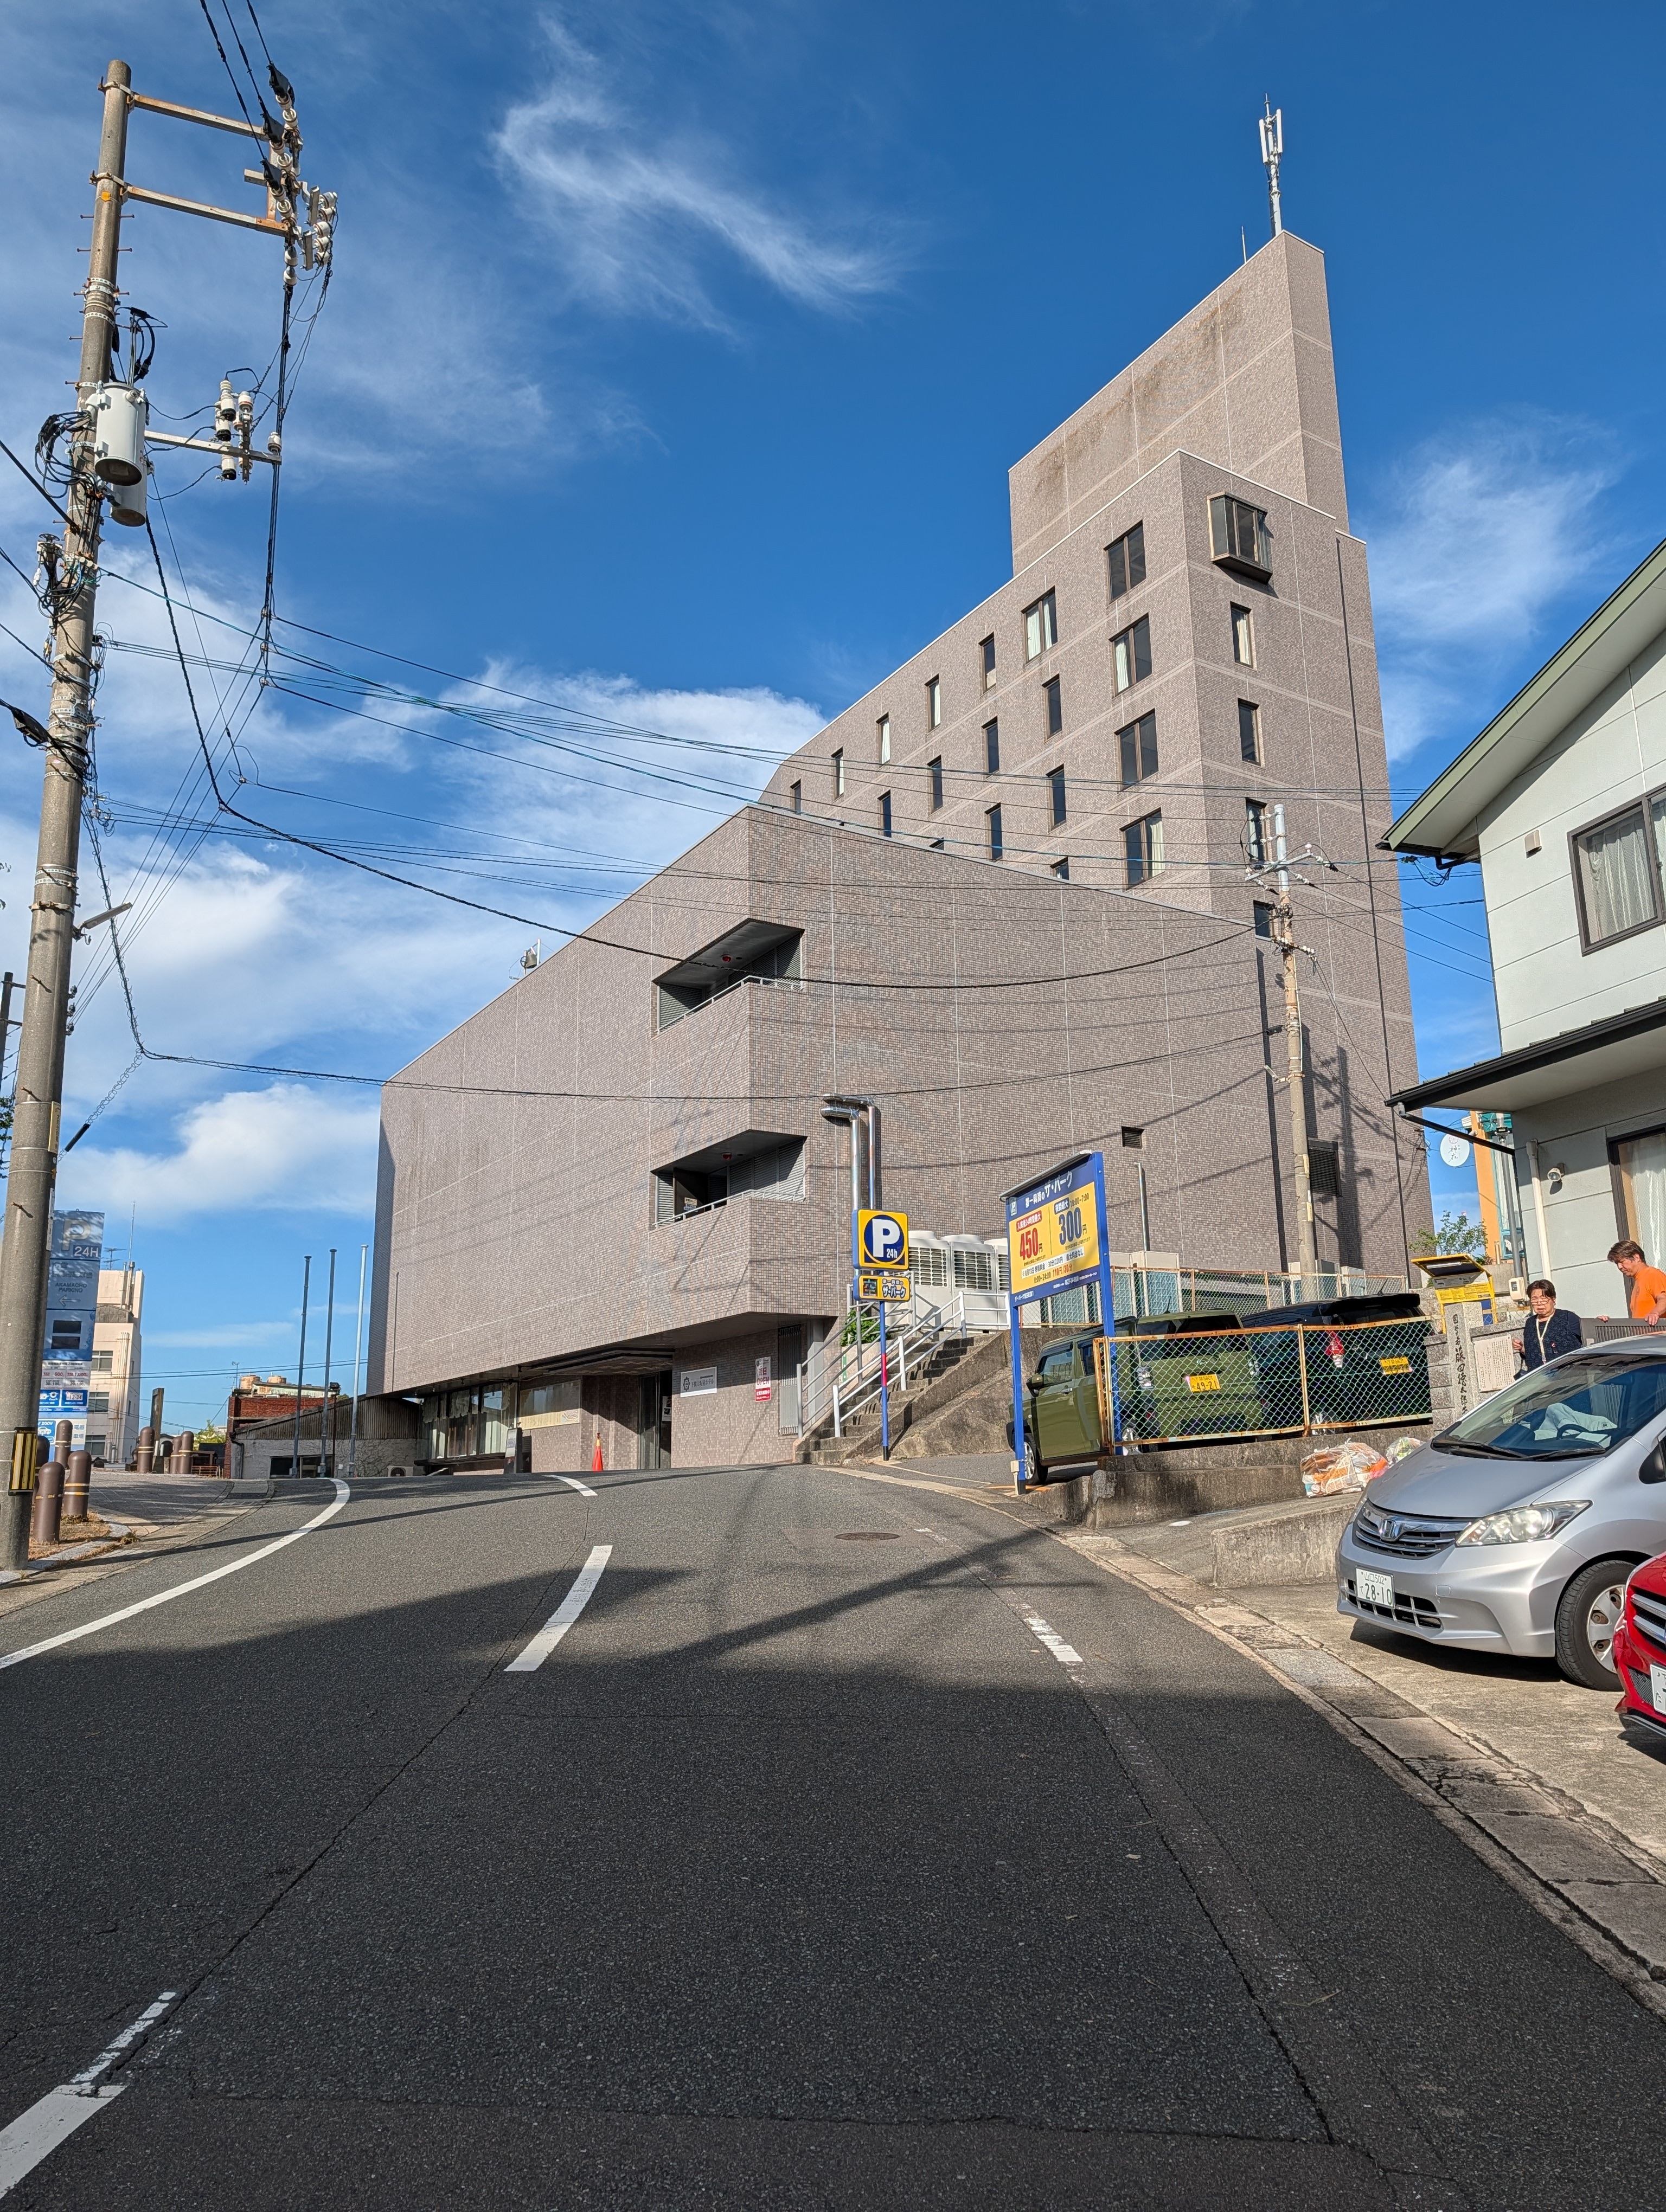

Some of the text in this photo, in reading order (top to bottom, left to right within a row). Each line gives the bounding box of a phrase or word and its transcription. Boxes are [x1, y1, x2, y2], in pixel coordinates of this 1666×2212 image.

[1059, 1207, 1087, 1245] 300円
[62, 1218, 91, 1251] P
[872, 1218, 900, 1257] P
[1020, 1227, 1043, 1261] 450円
[74, 1246, 99, 1258] 24H
[886, 1248, 898, 1258] 24h
[863, 1279, 877, 1296] 空
[882, 1284, 906, 1298] ザ・パーク
[757, 1377, 770, 1386] OPEN
[1196, 1380, 1218, 1391] 49-21
[1364, 1572, 1385, 1585] 山口502
[1360, 1583, 1392, 1605] て 28-10
[1656, 1692, 1663, 1703] た
